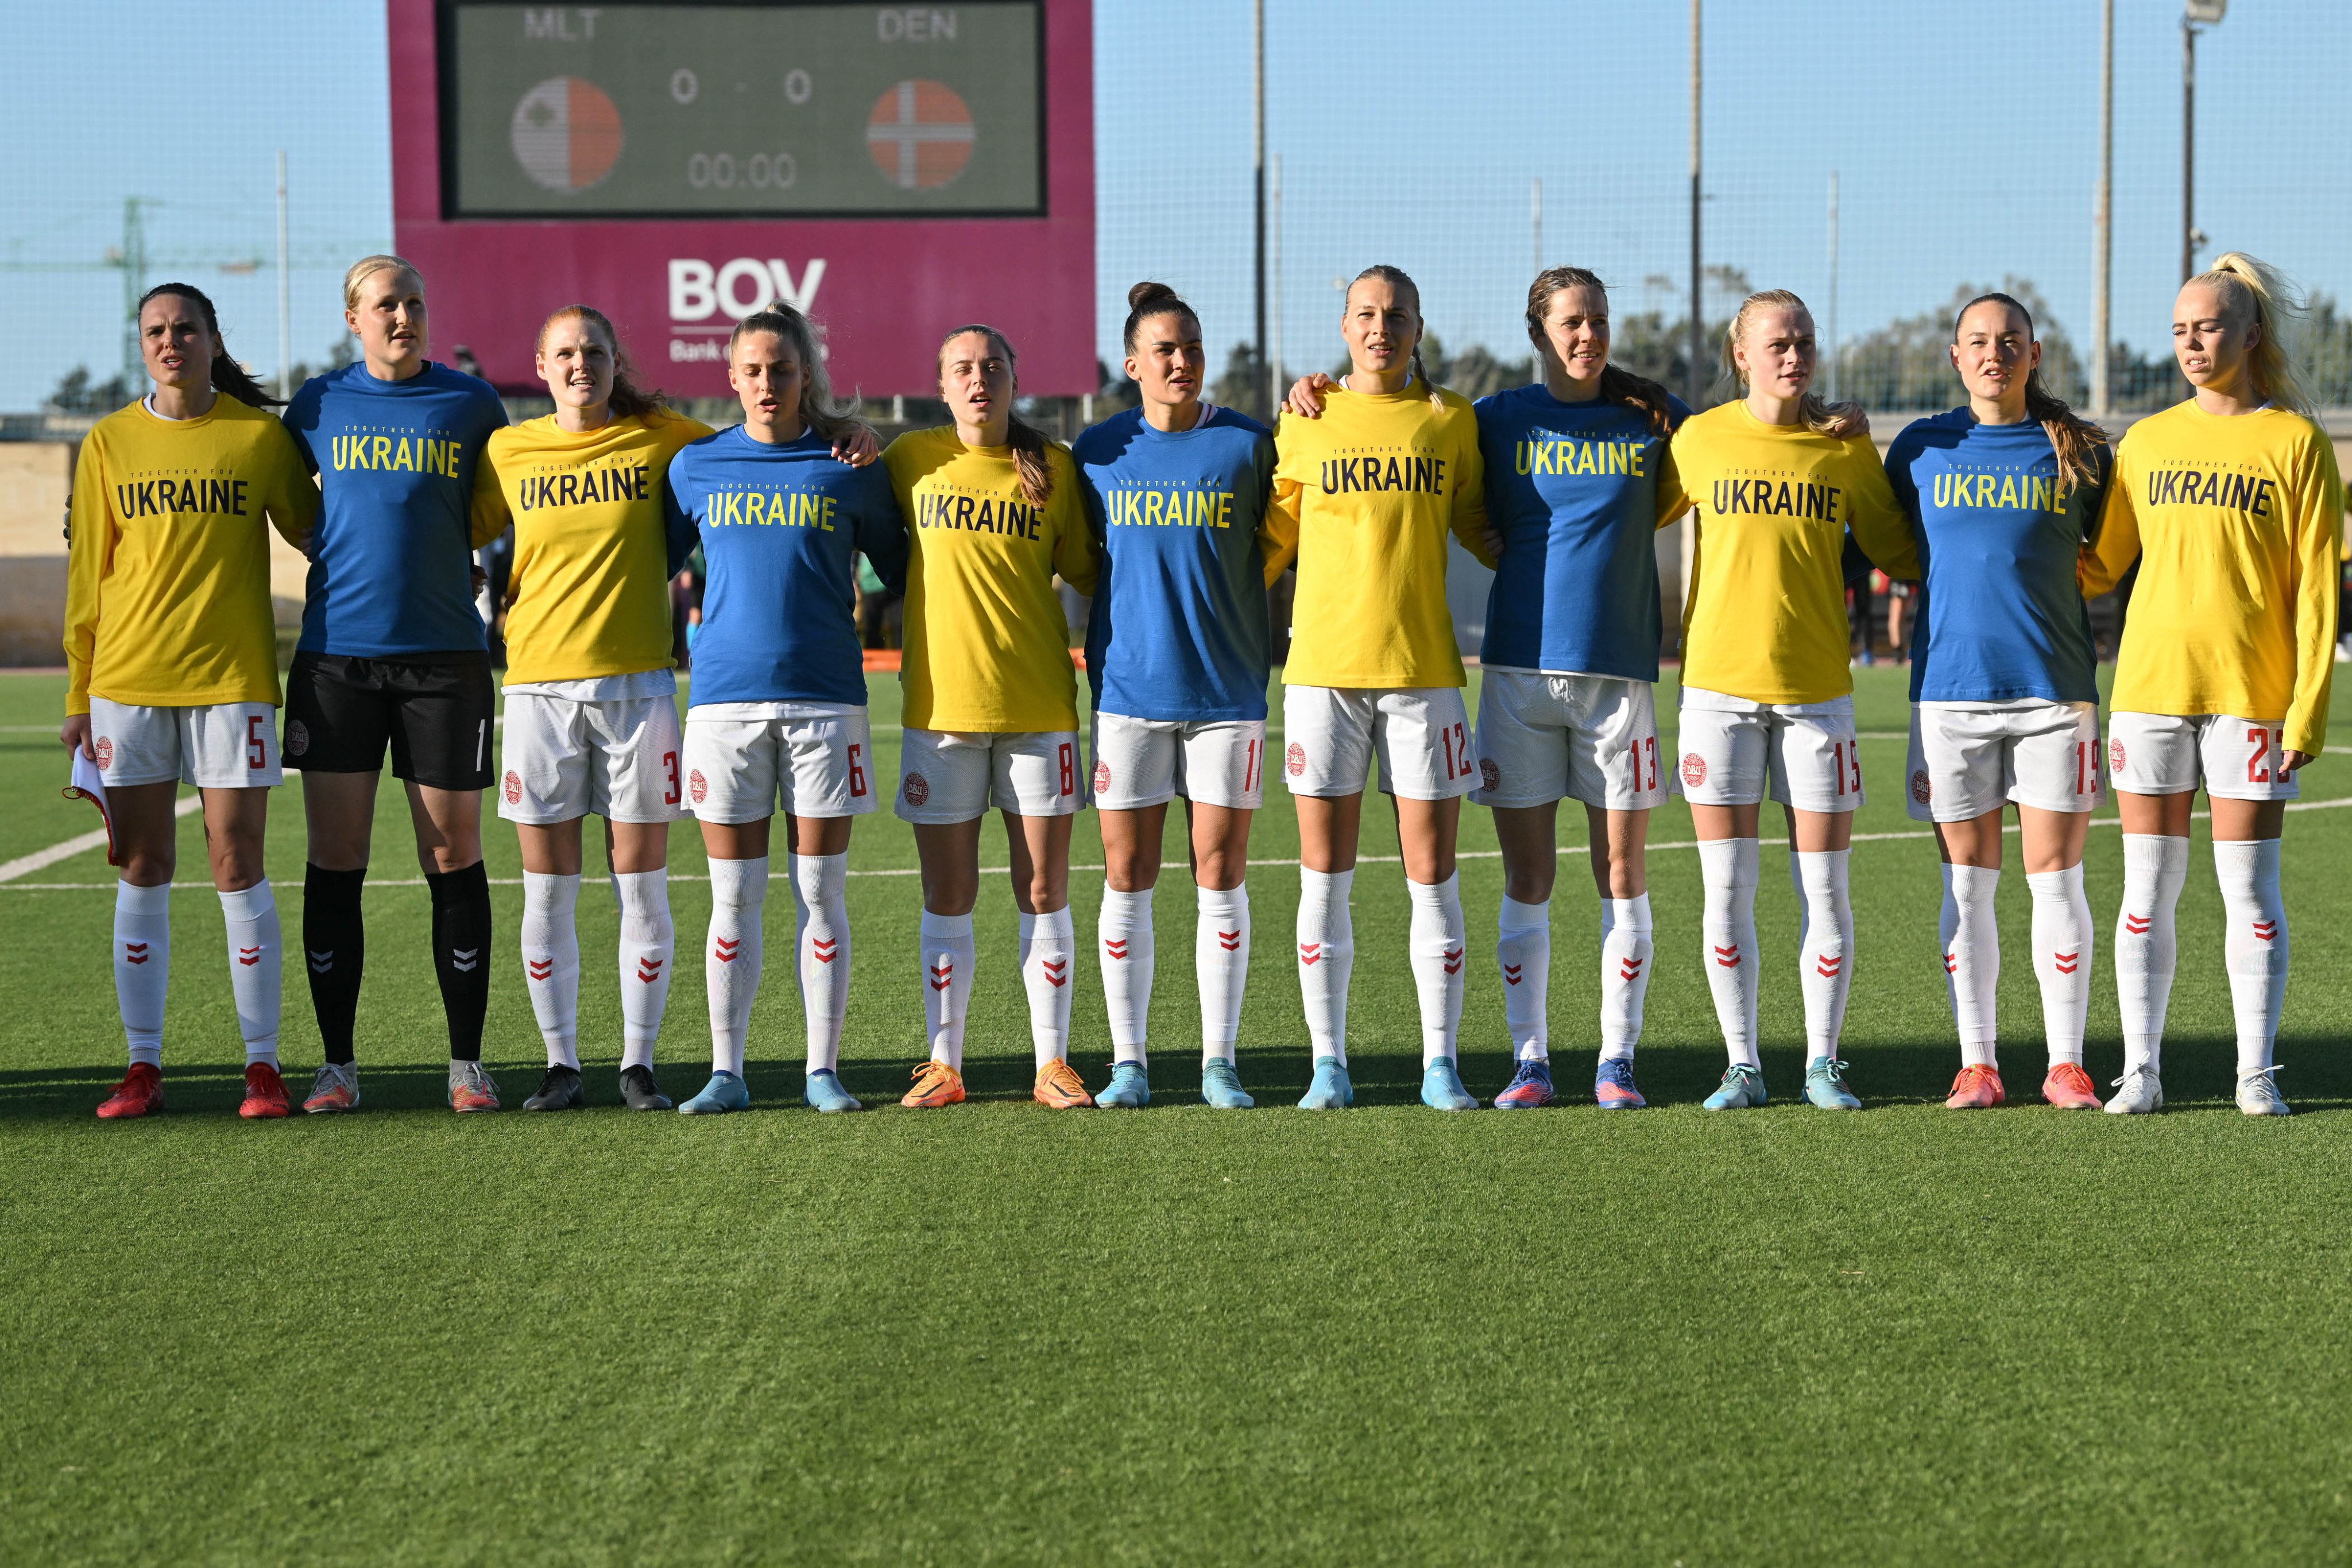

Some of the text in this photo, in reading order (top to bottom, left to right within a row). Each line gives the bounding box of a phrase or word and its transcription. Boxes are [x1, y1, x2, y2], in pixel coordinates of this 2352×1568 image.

[524, 9, 602, 41] MLT
[877, 9, 957, 42] DEN
[670, 68, 698, 105] 0
[784, 68, 812, 106] 0
[689, 153, 797, 189] 00:00
[668, 258, 826, 320] BOV
[670, 338, 722, 363] Bank
[345, 425, 451, 436] TOGETHER FOR
[1531, 430, 1596, 438] TOGETHER
[332, 436, 462, 479] UKRAINE
[533, 460, 598, 473] TOGETHER
[1334, 446, 1436, 455] TOGETHER FOR
[1515, 440, 1645, 477] UKRAINE
[1948, 463, 2020, 472] TOGETHER
[2163, 460, 2262, 473] TOGETHER FOR
[130, 469, 198, 478] TOGETHER
[521, 466, 649, 511] UKRAINE
[933, 483, 998, 496] TOGETHER
[1322, 456, 1445, 496] UKRAINE
[1727, 469, 1828, 482] TOGETHER FOR
[118, 479, 248, 520] UKRAINE
[1108, 490, 1234, 528] UKRAINE
[1713, 478, 1841, 524] UKRAINE
[1934, 474, 2066, 515] UKRAINE
[2149, 470, 2276, 517] UKRAINE
[707, 492, 837, 532] UKRAINE
[920, 493, 1045, 541] UKRAINE
[99, 748, 109, 758] DBU
[248, 715, 266, 769] 5
[292, 731, 304, 742] DBU
[476, 718, 486, 772] 1
[1442, 722, 1473, 781] 12
[848, 743, 867, 797] 6
[1058, 742, 1073, 796] 8
[1095, 771, 1106, 781] DBU
[1244, 739, 1263, 792] 11
[1291, 754, 1302, 765] DBU
[1483, 769, 1495, 781] DBU
[1630, 735, 1657, 793] 13
[1686, 765, 1701, 776] DBU
[1835, 740, 1860, 796] 15
[2076, 738, 2099, 795] 19
[509, 781, 519, 793] DBU
[663, 751, 680, 805] 3
[693, 781, 703, 791] DBU
[909, 783, 922, 795] DBU
[1917, 781, 1929, 793] DBU
